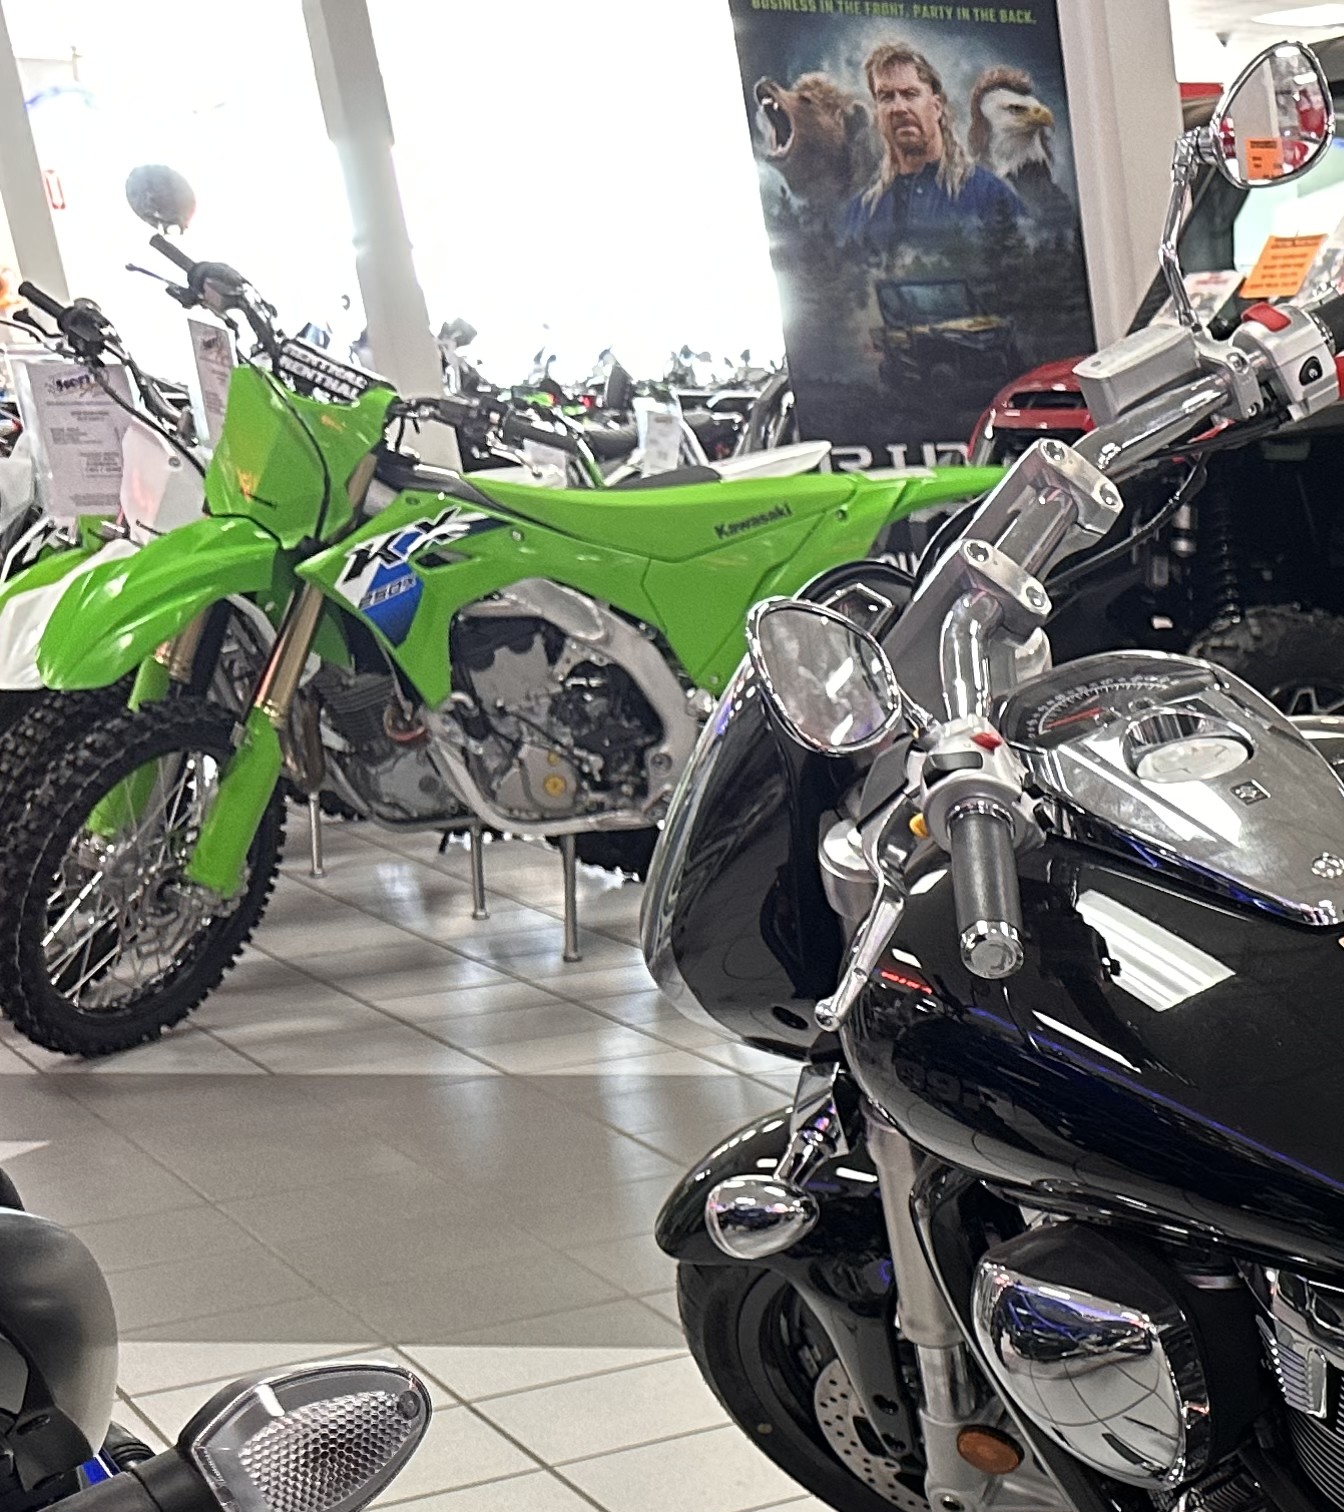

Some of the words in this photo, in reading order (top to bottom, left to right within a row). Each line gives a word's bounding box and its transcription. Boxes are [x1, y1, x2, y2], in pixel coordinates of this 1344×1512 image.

[752, 0, 817, 12] BUSINESS
[820, 0, 834, 13] IN
[838, 1, 861, 15] THE
[913, 4, 953, 20] PARTY
[956, 7, 970, 20] IN
[973, 7, 998, 22] THE
[713, 501, 793, 540] Kawasaki
